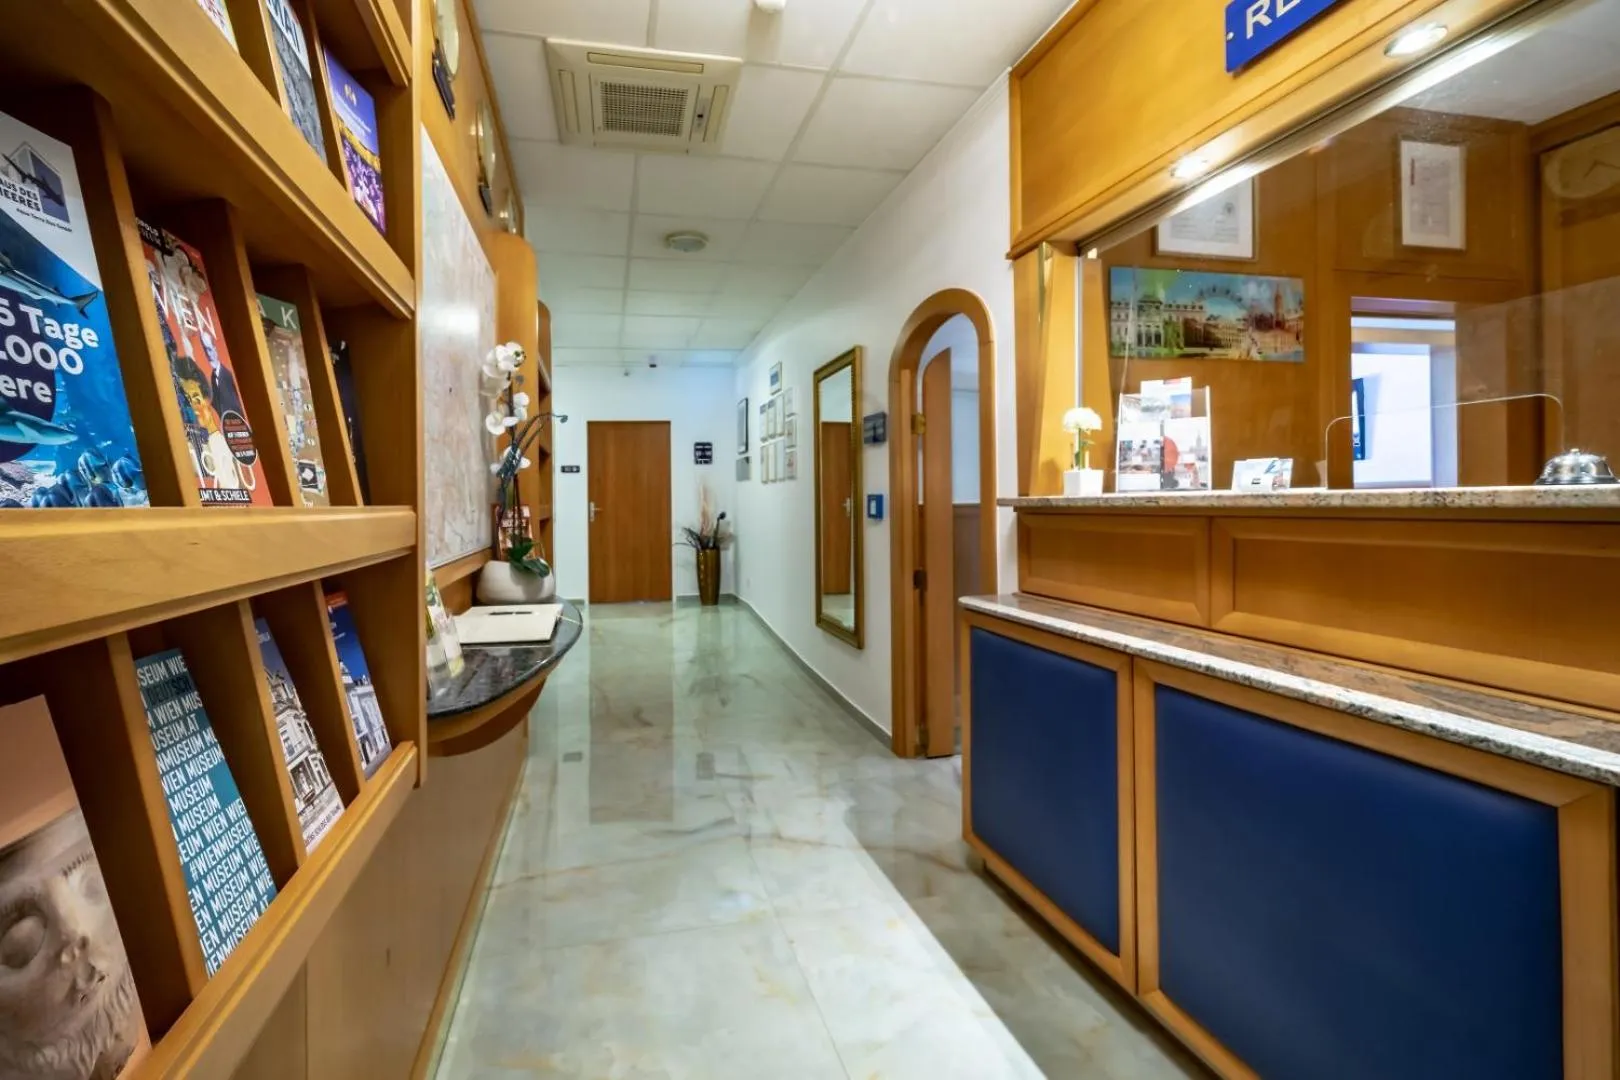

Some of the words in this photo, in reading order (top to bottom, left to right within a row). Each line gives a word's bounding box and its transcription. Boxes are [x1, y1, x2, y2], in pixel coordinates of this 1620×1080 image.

[19, 303, 99, 350] Tage
[221, 489, 250, 502] SCHIELE
[135, 661, 169, 688] SEUM
[153, 699, 183, 725] WIEN
[184, 744, 225, 780] MUSEUM
[168, 774, 213, 816] MUSEUM
[177, 793, 221, 836] MUSEUM
[177, 831, 204, 866] EUM
[201, 811, 229, 842] WIEN
[201, 848, 244, 897] MUSEUM
[210, 866, 251, 918] MUSEUM
[217, 885, 258, 938] MUSEUM
